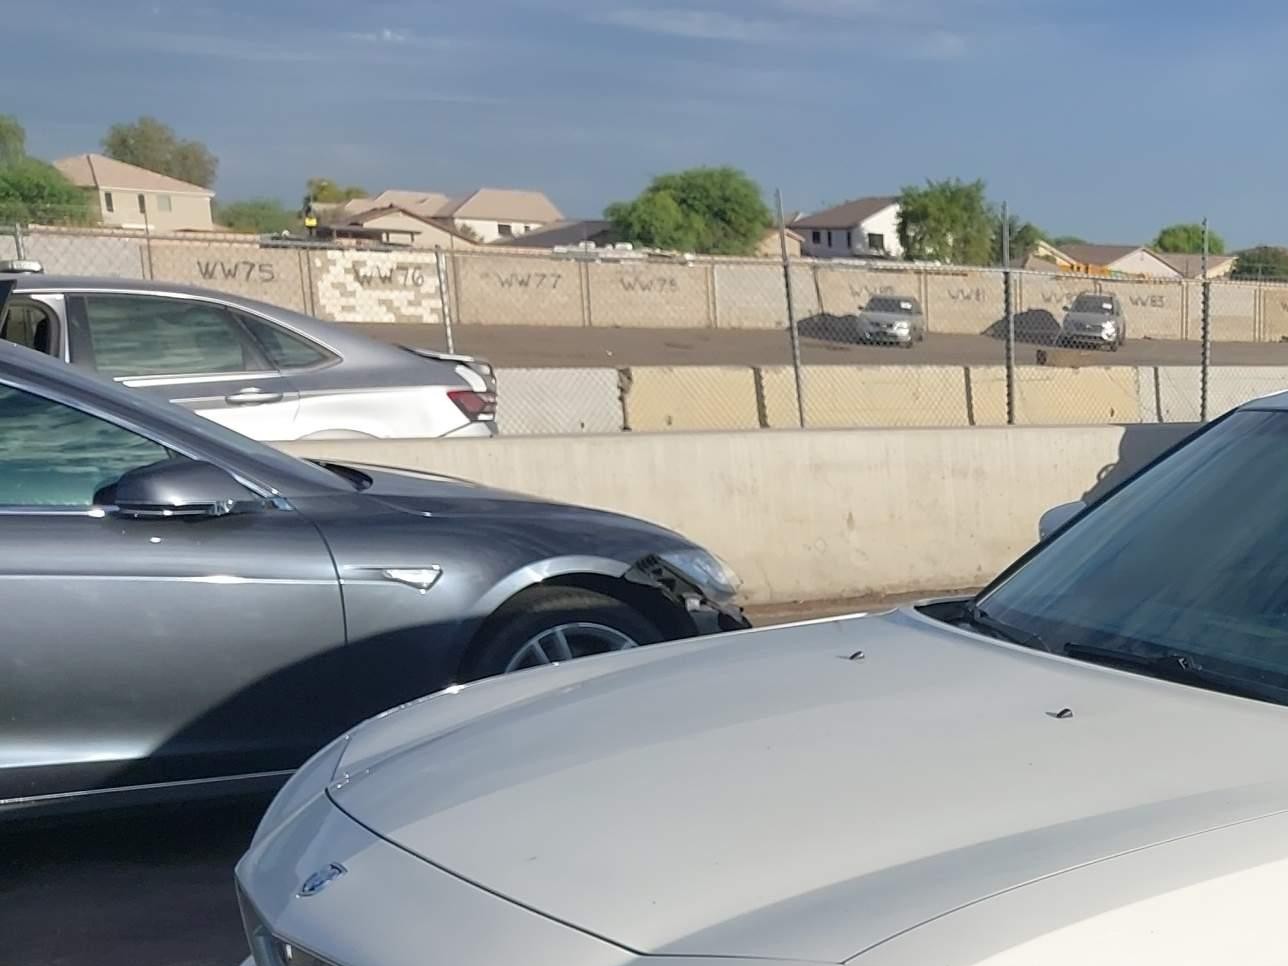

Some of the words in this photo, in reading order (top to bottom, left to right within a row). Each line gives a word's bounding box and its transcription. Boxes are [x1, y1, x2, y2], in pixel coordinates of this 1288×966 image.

[197, 260, 275, 283] WW75
[352, 261, 425, 287] WW76
[496, 272, 563, 289] WW77
